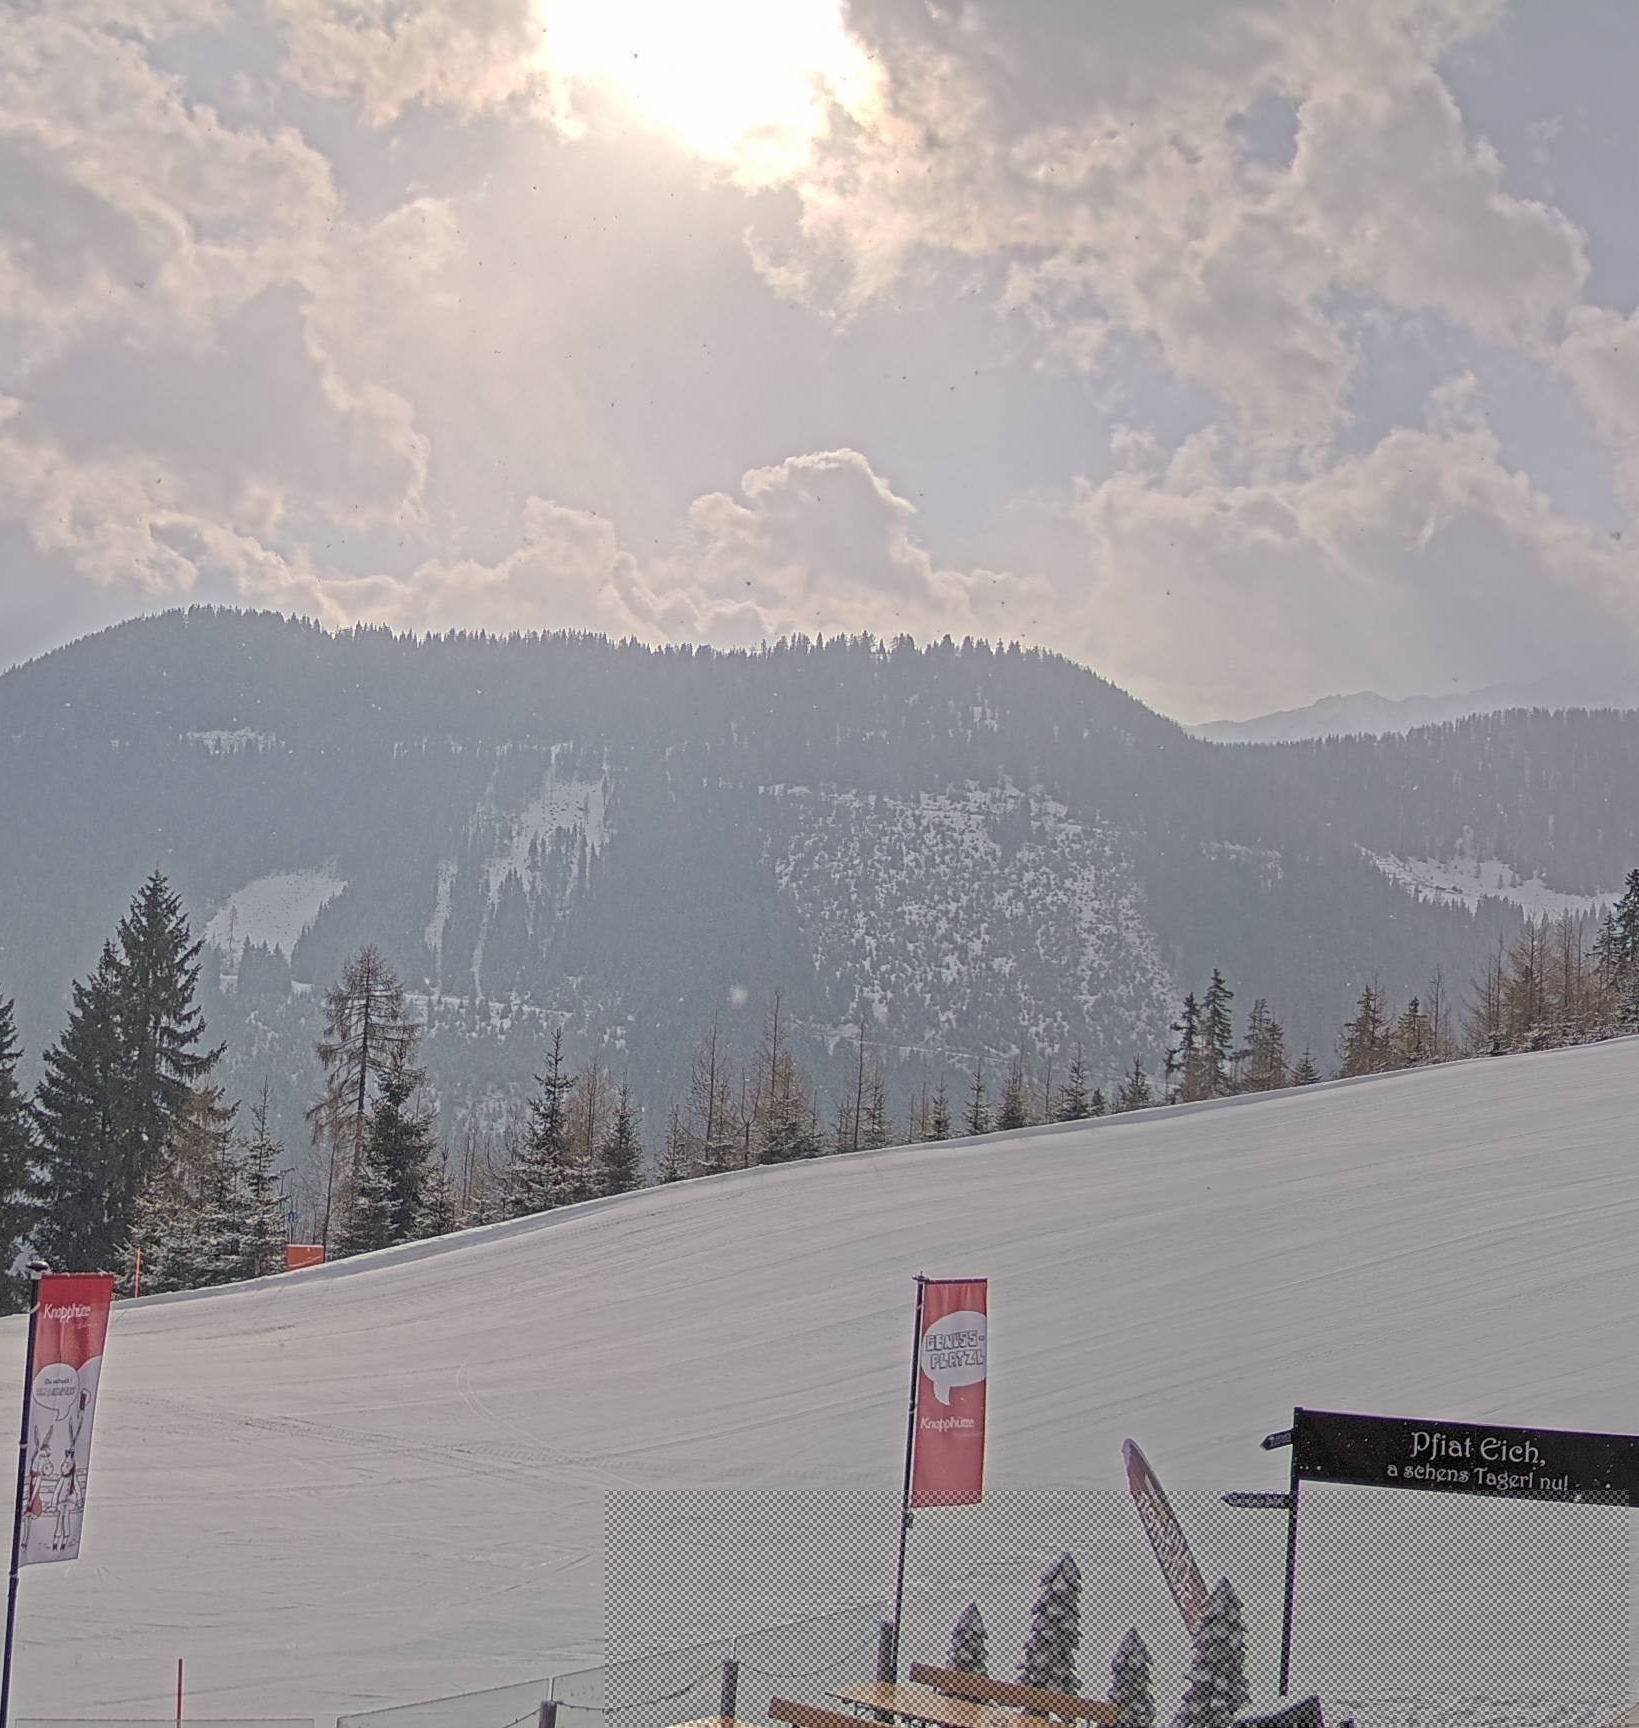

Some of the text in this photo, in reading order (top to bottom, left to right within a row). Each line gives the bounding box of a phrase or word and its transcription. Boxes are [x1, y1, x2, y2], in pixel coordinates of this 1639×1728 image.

[1410, 1431, 1546, 1467] Pfiat Eich,
[1387, 1464, 1398, 1477] a
[1403, 1463, 1470, 1483] schens
[1473, 1467, 1533, 1490] Tagerl
